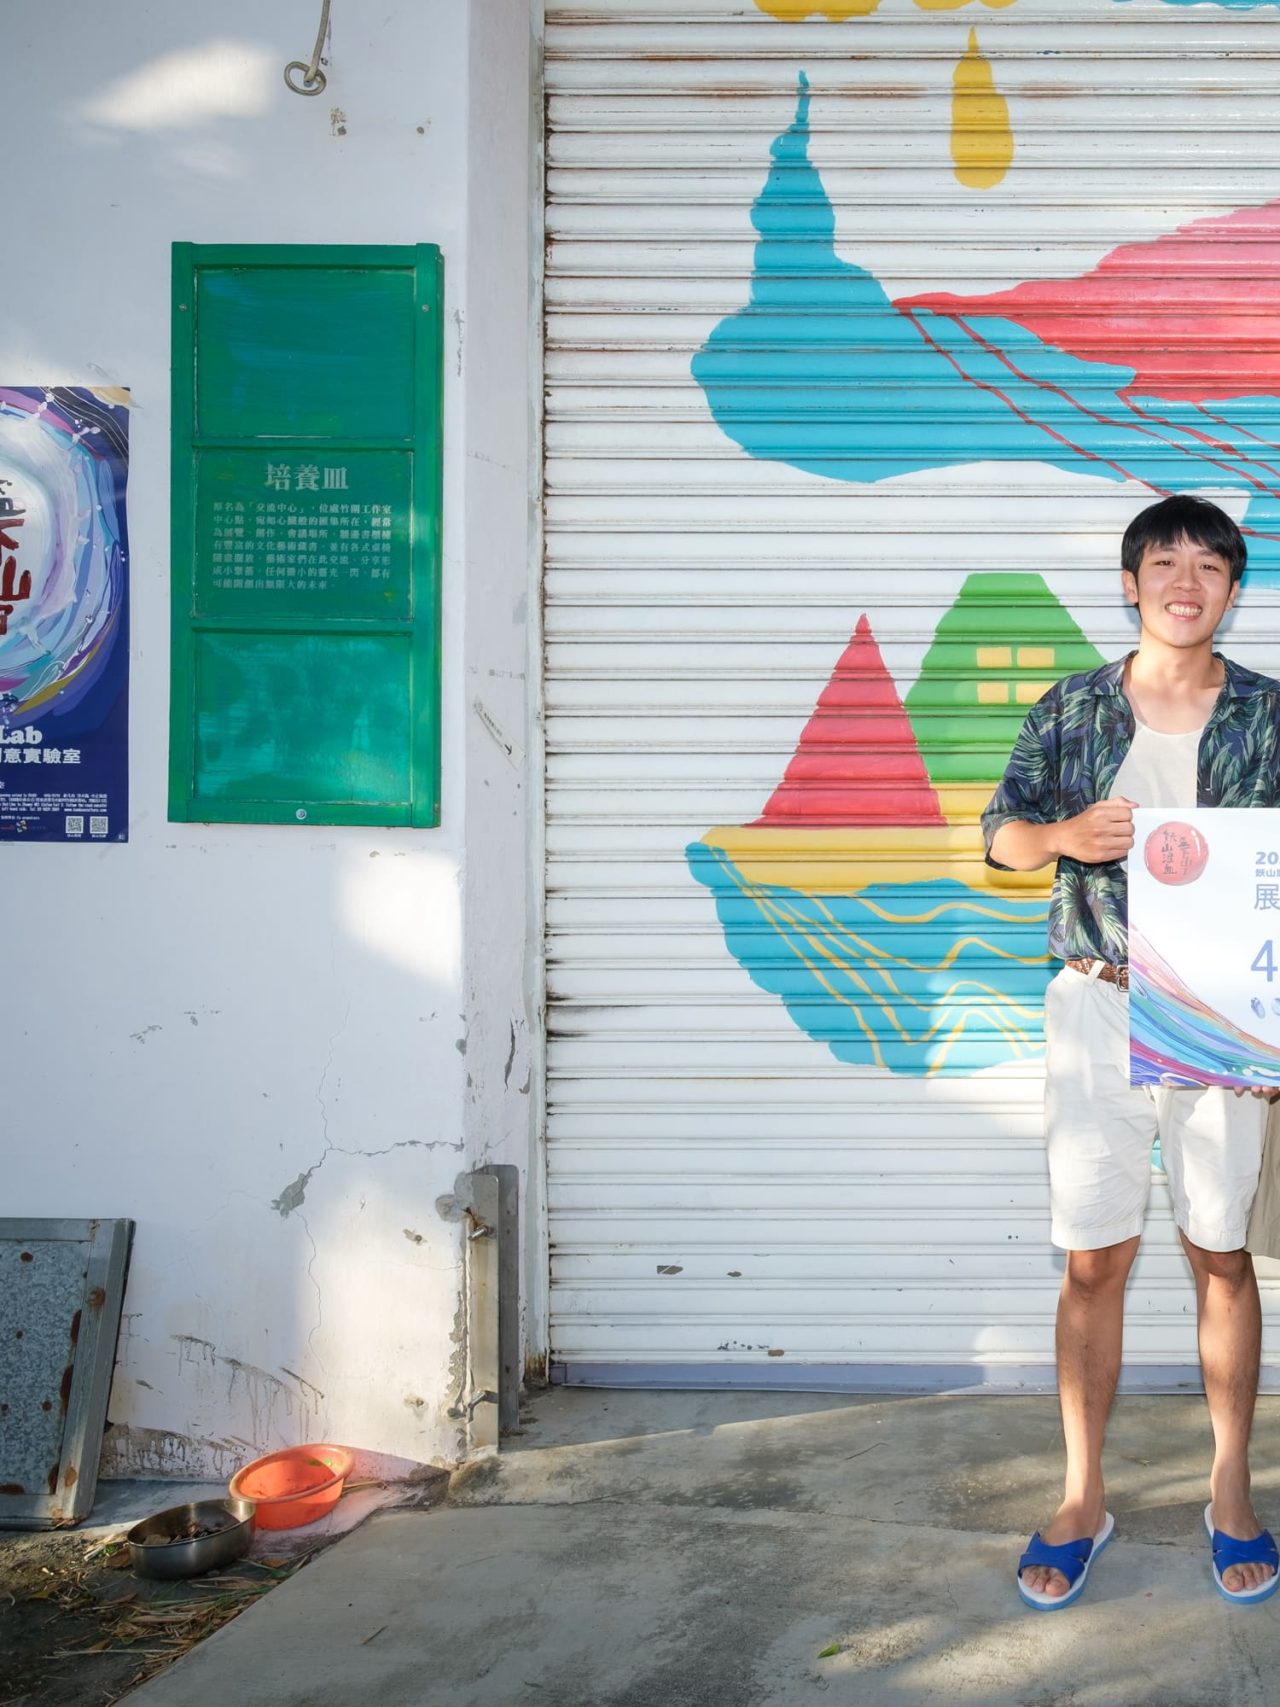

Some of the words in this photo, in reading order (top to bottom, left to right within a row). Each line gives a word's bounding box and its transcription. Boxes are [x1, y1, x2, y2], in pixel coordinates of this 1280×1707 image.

[264, 462, 349, 492] 培養皿
[0, 748, 81, 764] 意實驗室
